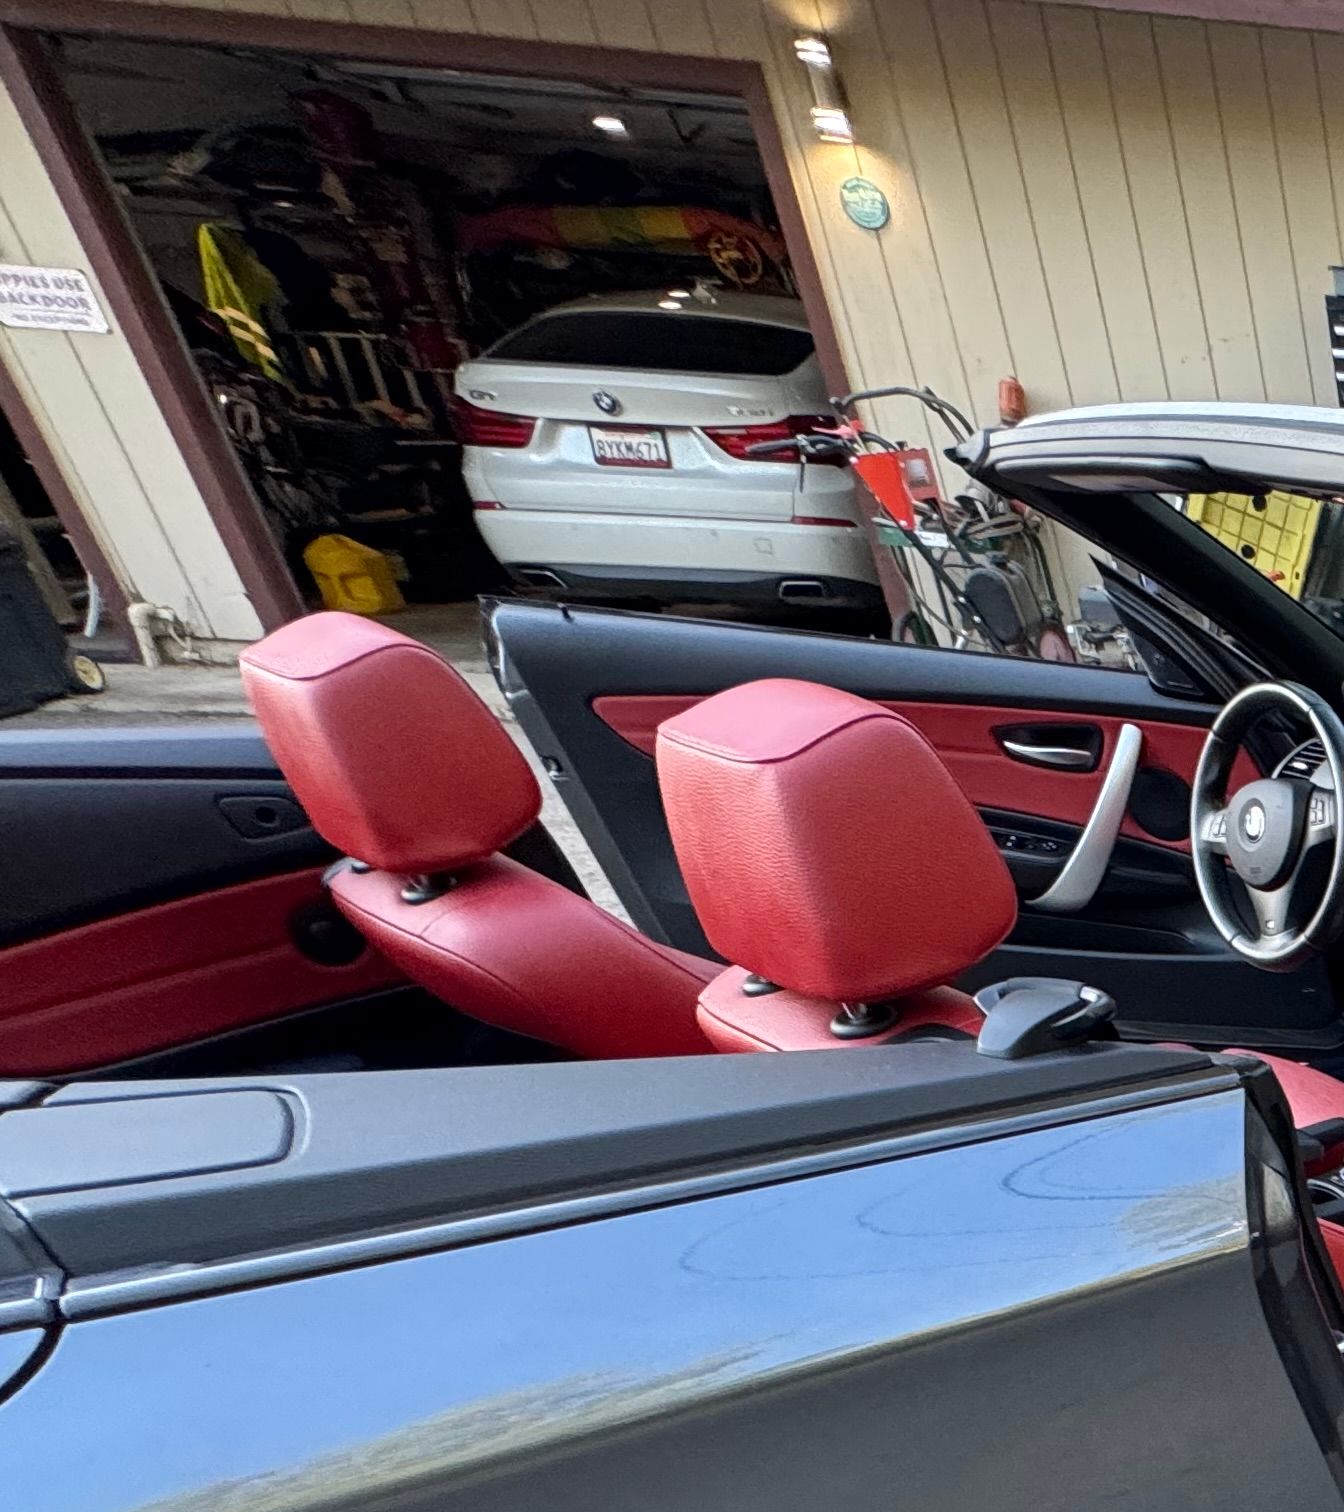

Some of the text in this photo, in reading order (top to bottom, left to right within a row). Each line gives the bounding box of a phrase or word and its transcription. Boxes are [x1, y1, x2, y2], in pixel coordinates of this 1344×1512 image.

[0, 273, 84, 292] PPIES USE
[596, 440, 663, 460] 8YKM671
